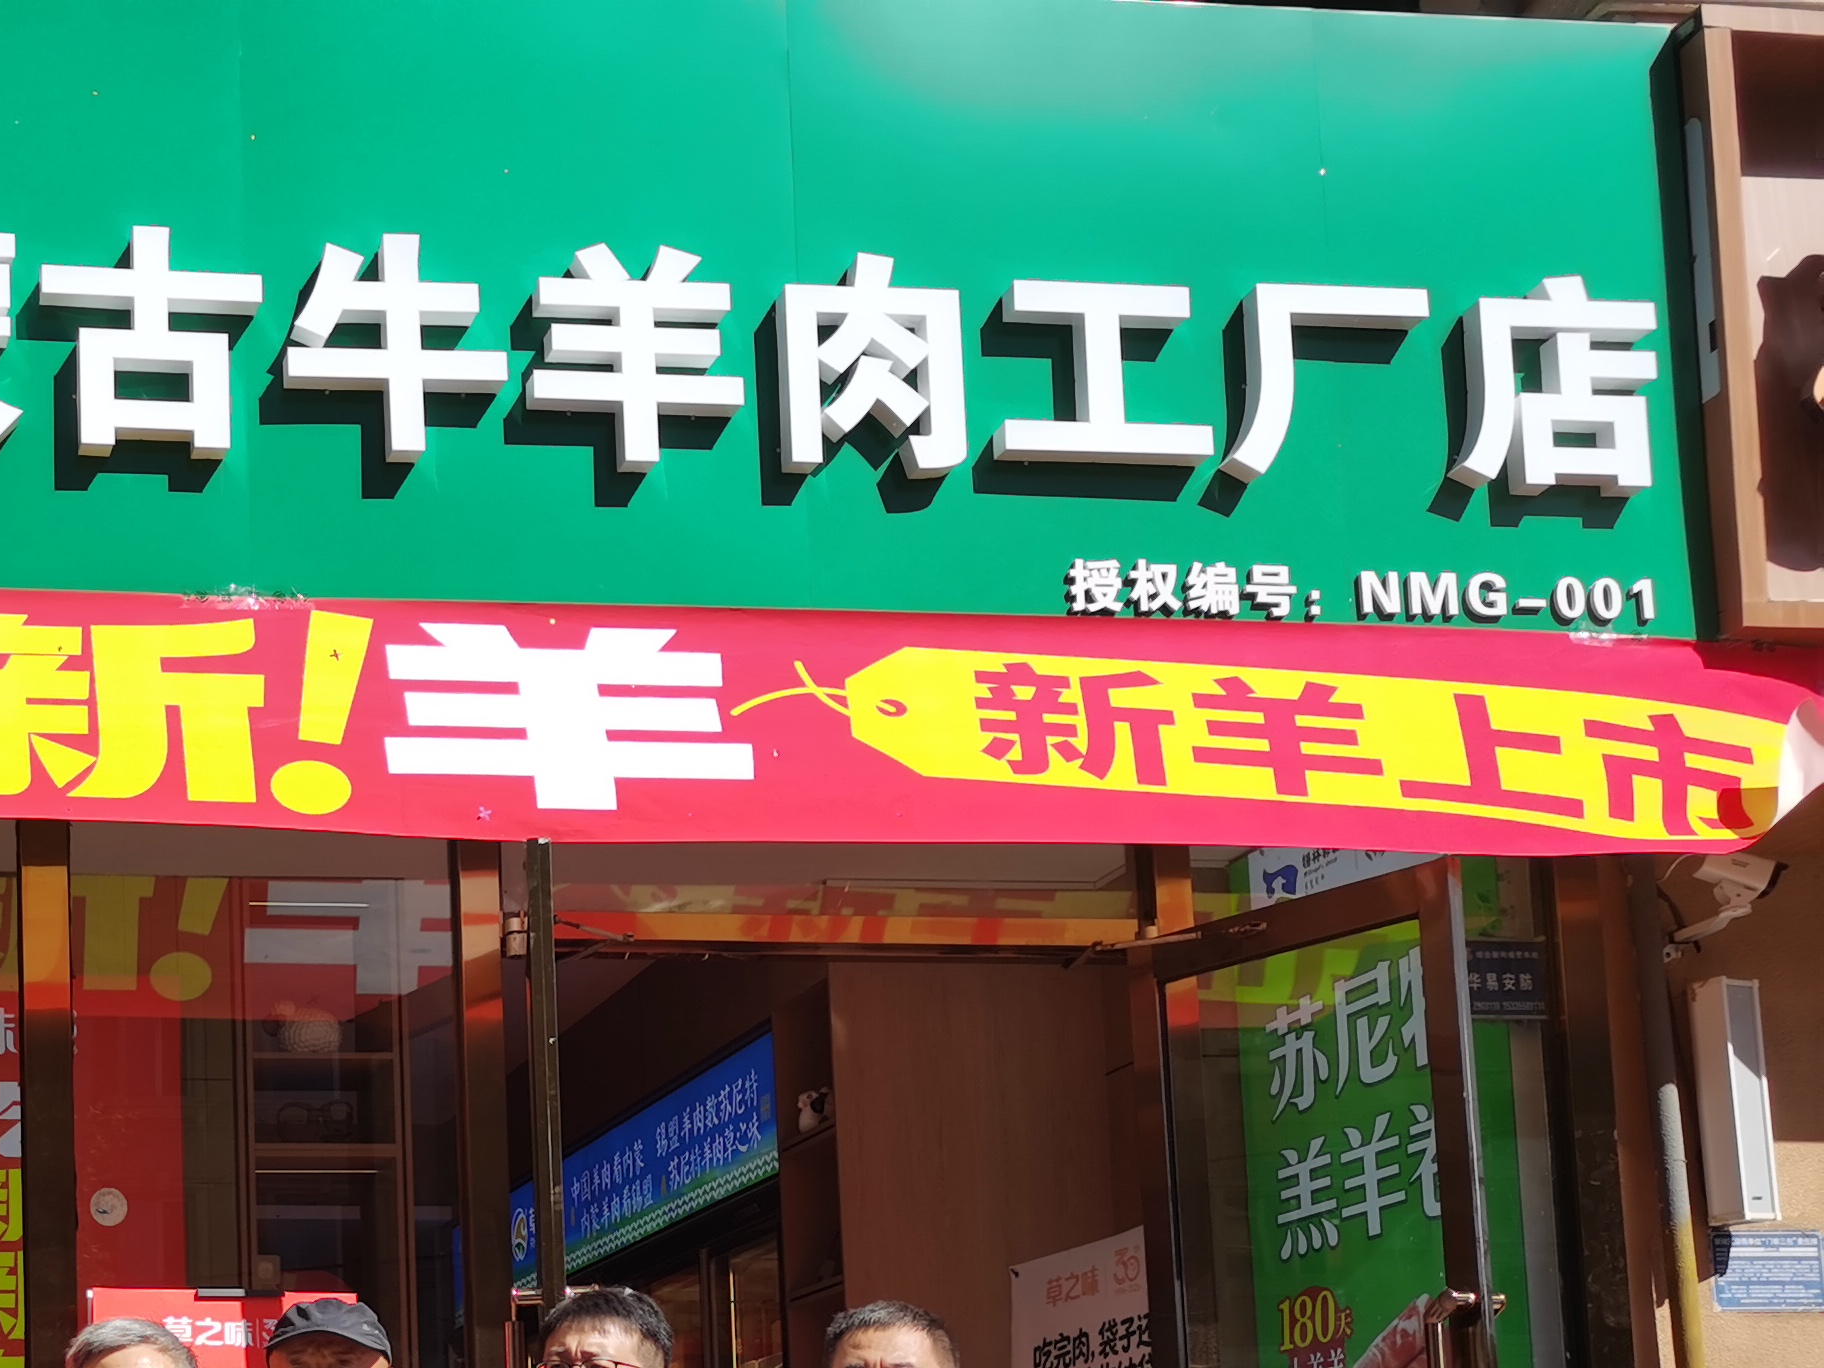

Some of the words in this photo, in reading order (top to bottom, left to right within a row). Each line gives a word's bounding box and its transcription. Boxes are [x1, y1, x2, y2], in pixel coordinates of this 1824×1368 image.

[1358, 570, 1657, 624] NMG-001
[973, 661, 1755, 837] 新羊上市
[1045, 1265, 1100, 1307] 草之味
